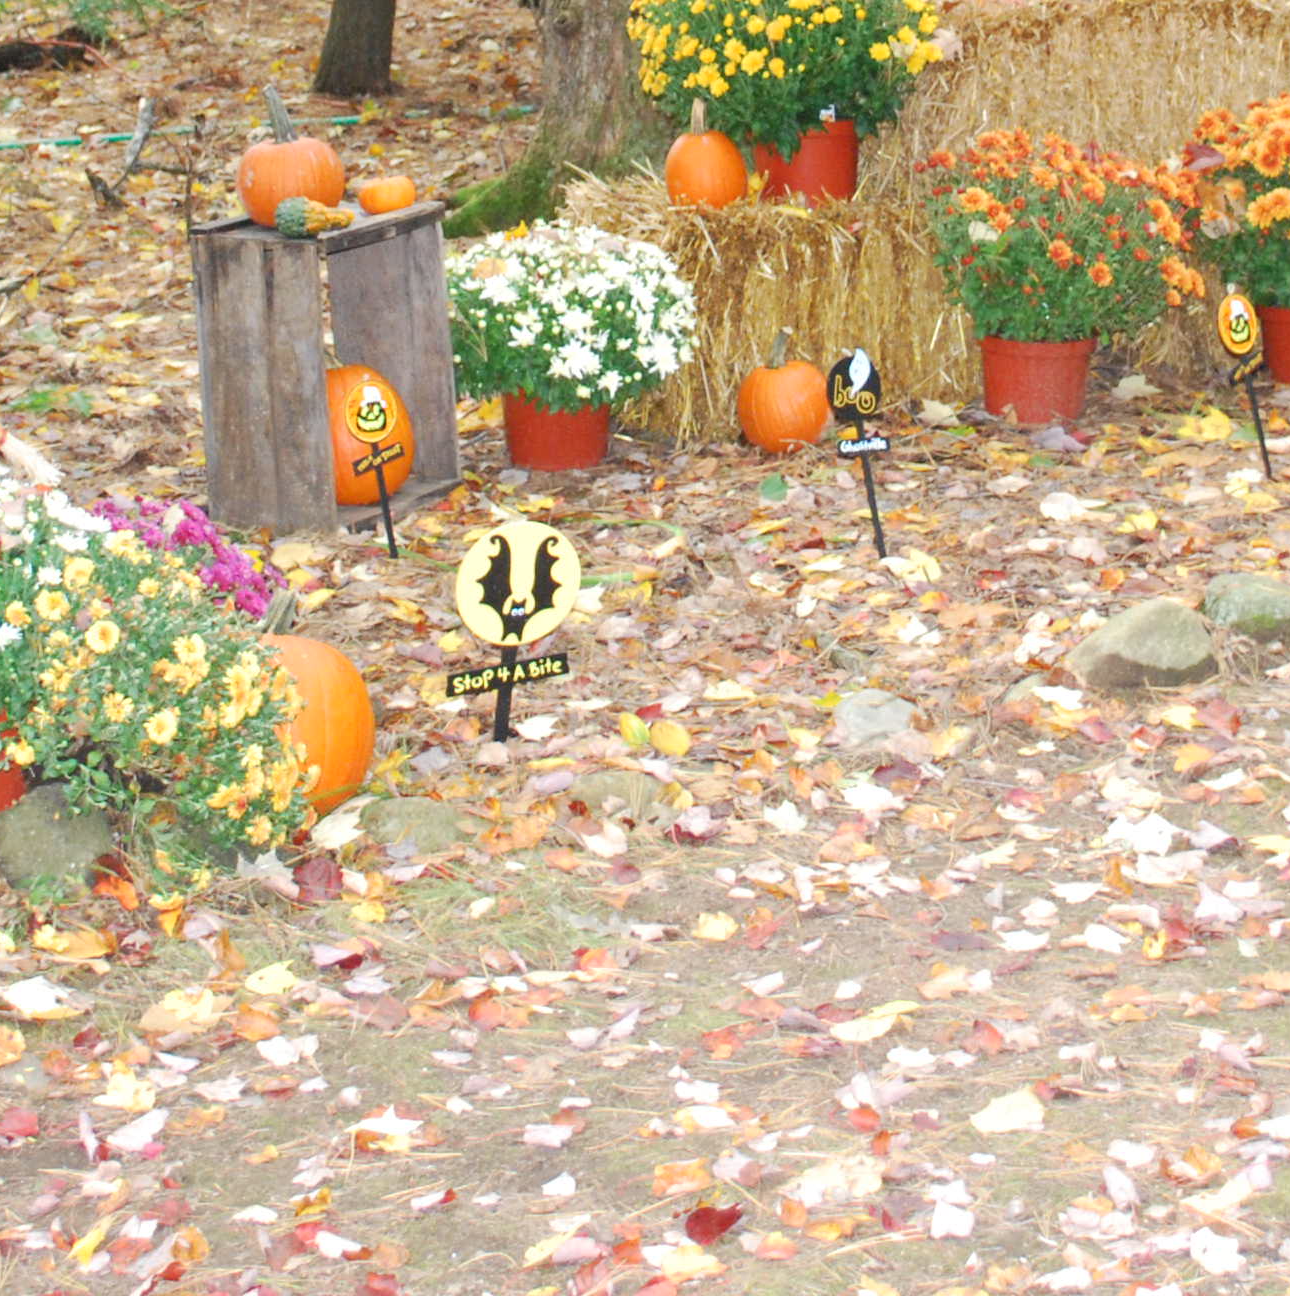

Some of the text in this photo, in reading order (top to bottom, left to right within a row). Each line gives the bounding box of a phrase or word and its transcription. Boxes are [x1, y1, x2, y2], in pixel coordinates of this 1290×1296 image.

[497, 666, 510, 682] 4
[513, 664, 526, 682] A
[528, 657, 563, 678] Bite
